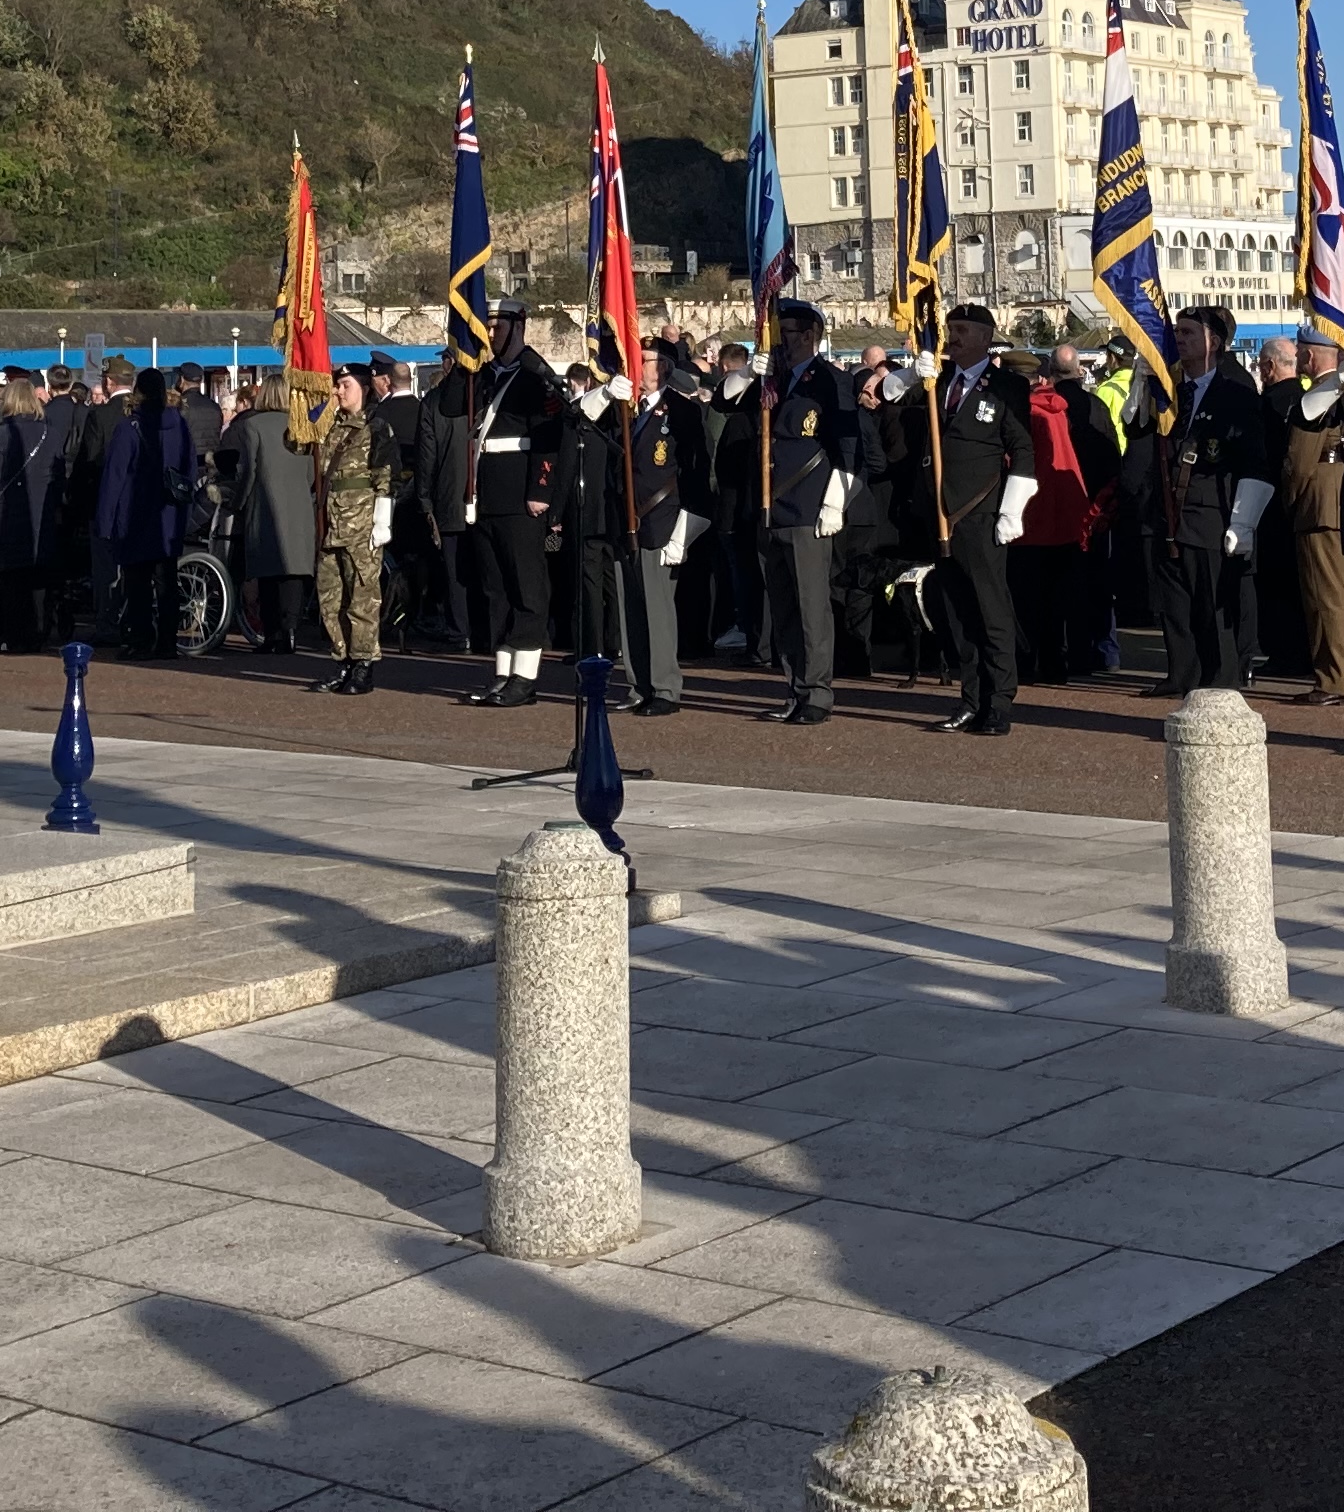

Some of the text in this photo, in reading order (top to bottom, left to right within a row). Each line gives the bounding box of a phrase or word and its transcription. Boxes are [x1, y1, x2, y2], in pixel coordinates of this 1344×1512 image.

[971, 24, 1045, 54] HOTEL
[1097, 143, 1144, 189] NDUDN
[1202, 276, 1270, 290] GRAND HOTEL
